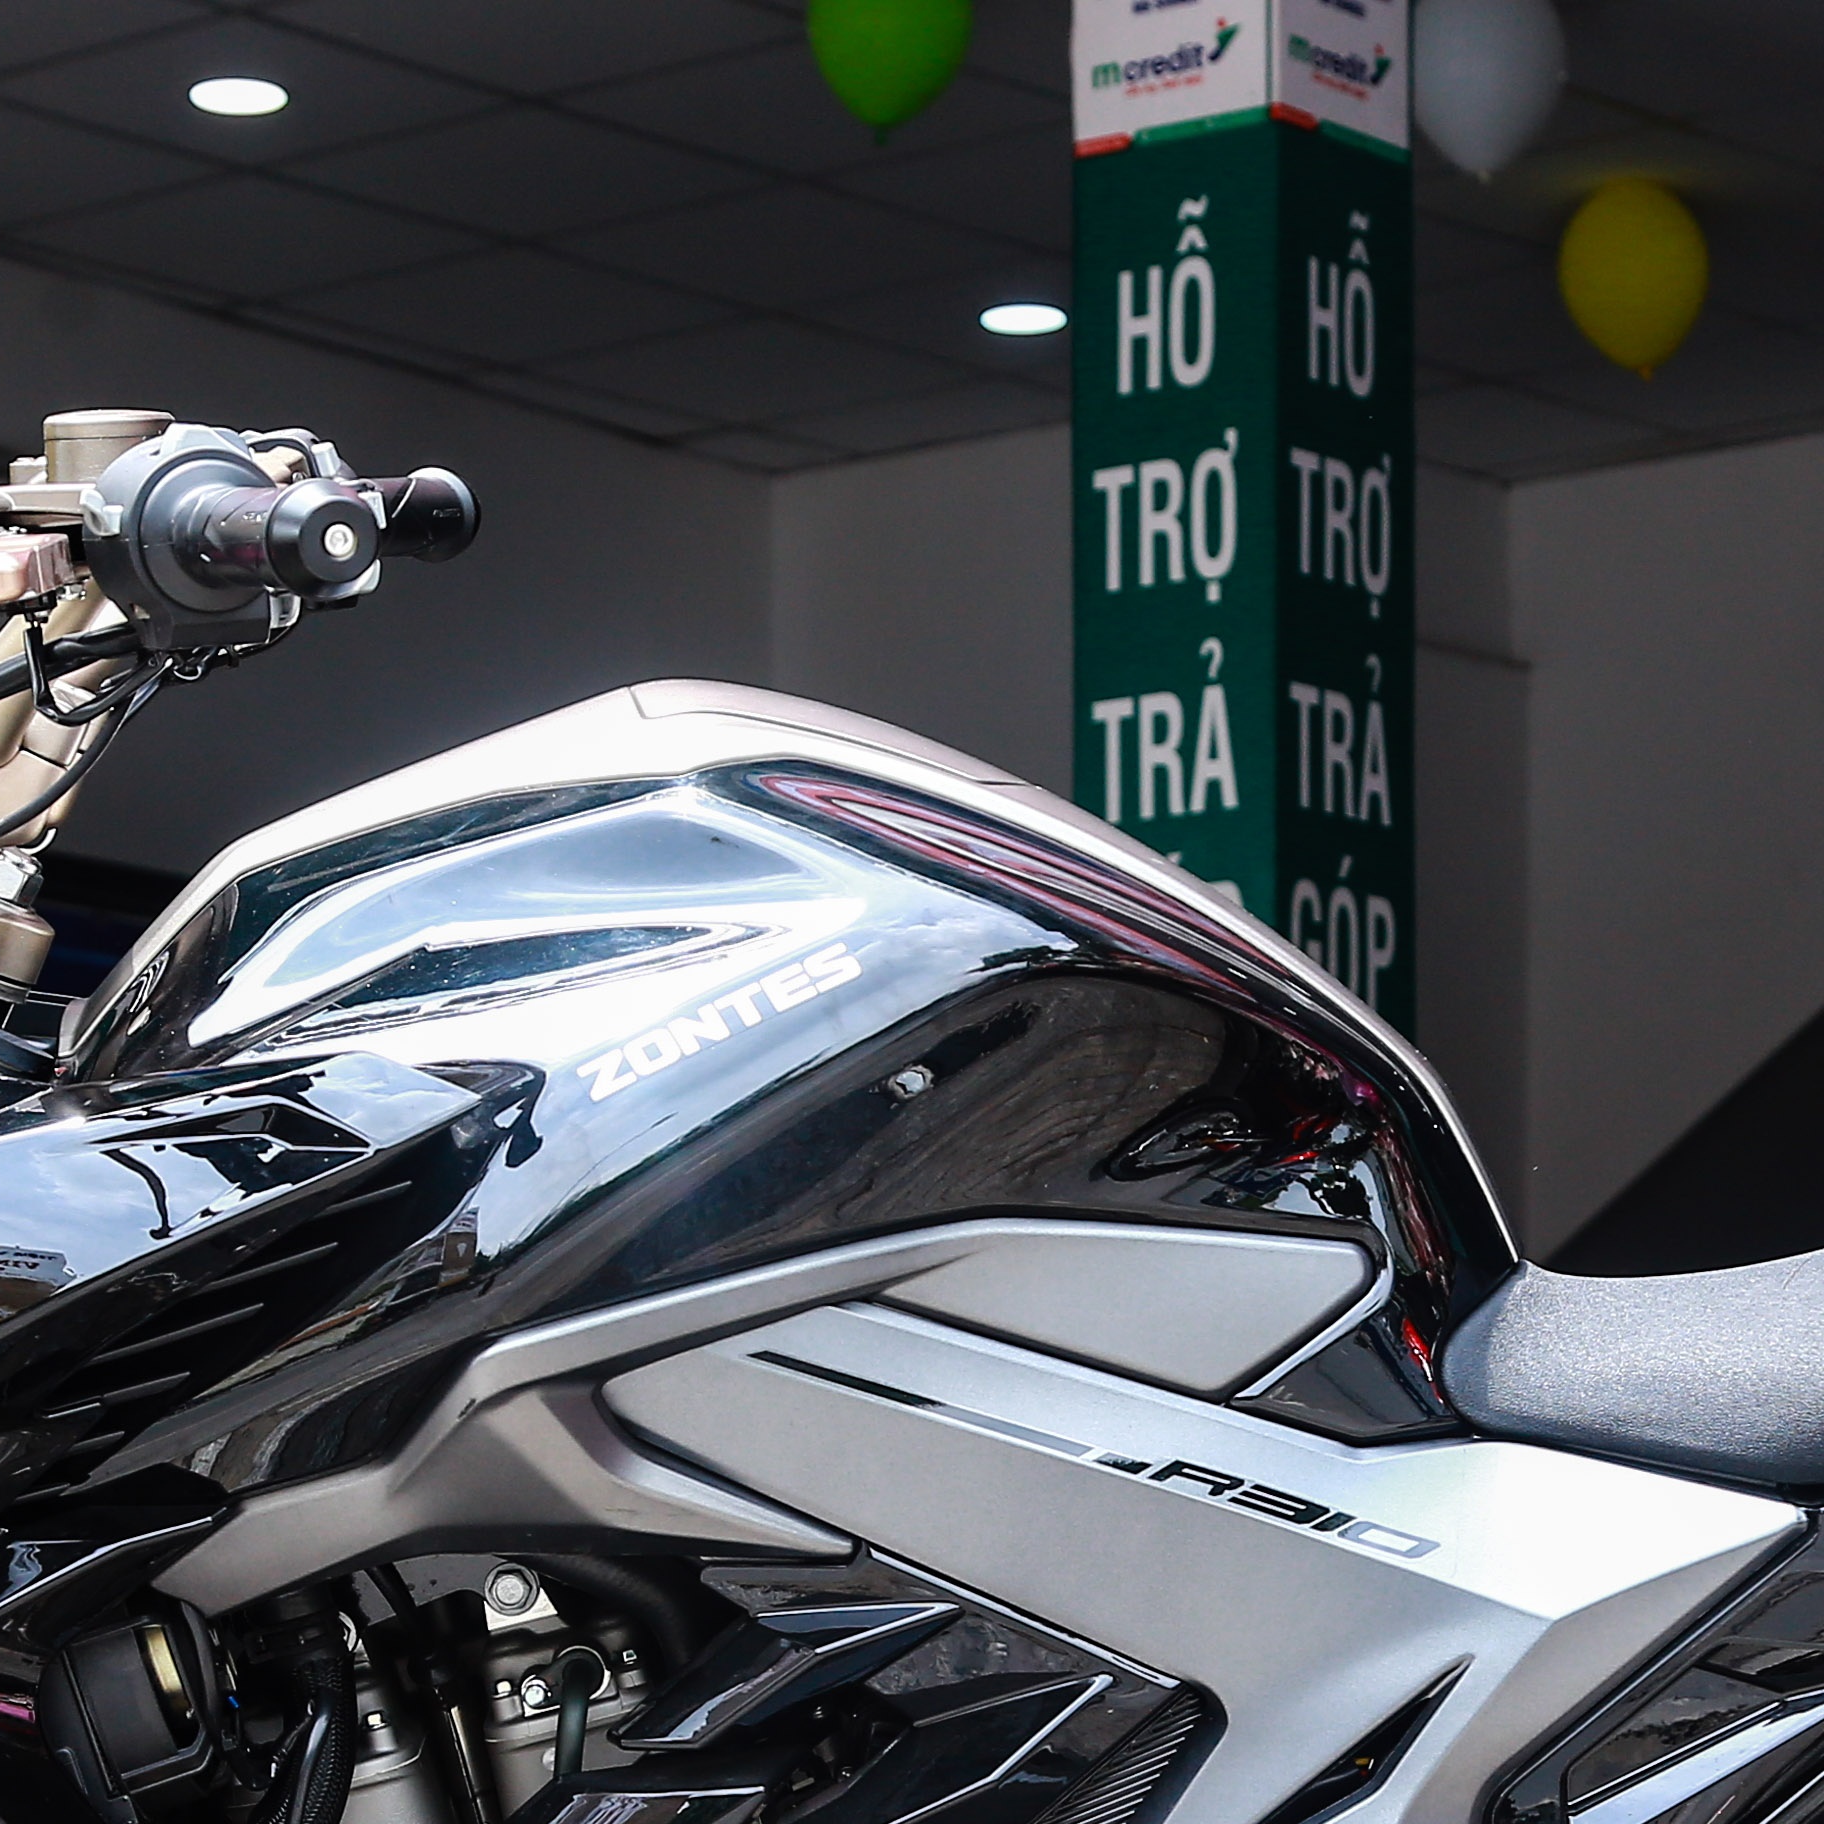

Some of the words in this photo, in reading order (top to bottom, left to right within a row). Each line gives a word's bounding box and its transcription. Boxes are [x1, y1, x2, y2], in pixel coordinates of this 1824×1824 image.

[1092, 39, 1205, 90] mcredit
[1117, 196, 1216, 396] HỖ
[1307, 210, 1376, 398] HỖ
[1092, 427, 1238, 603] TRỢ
[1290, 447, 1392, 619] TRỢ
[1092, 637, 1239, 824] TRẢ
[1289, 654, 1392, 827] TRẢ
[1290, 855, 1396, 1003] GÓP
[575, 941, 864, 1102] ZONTES
